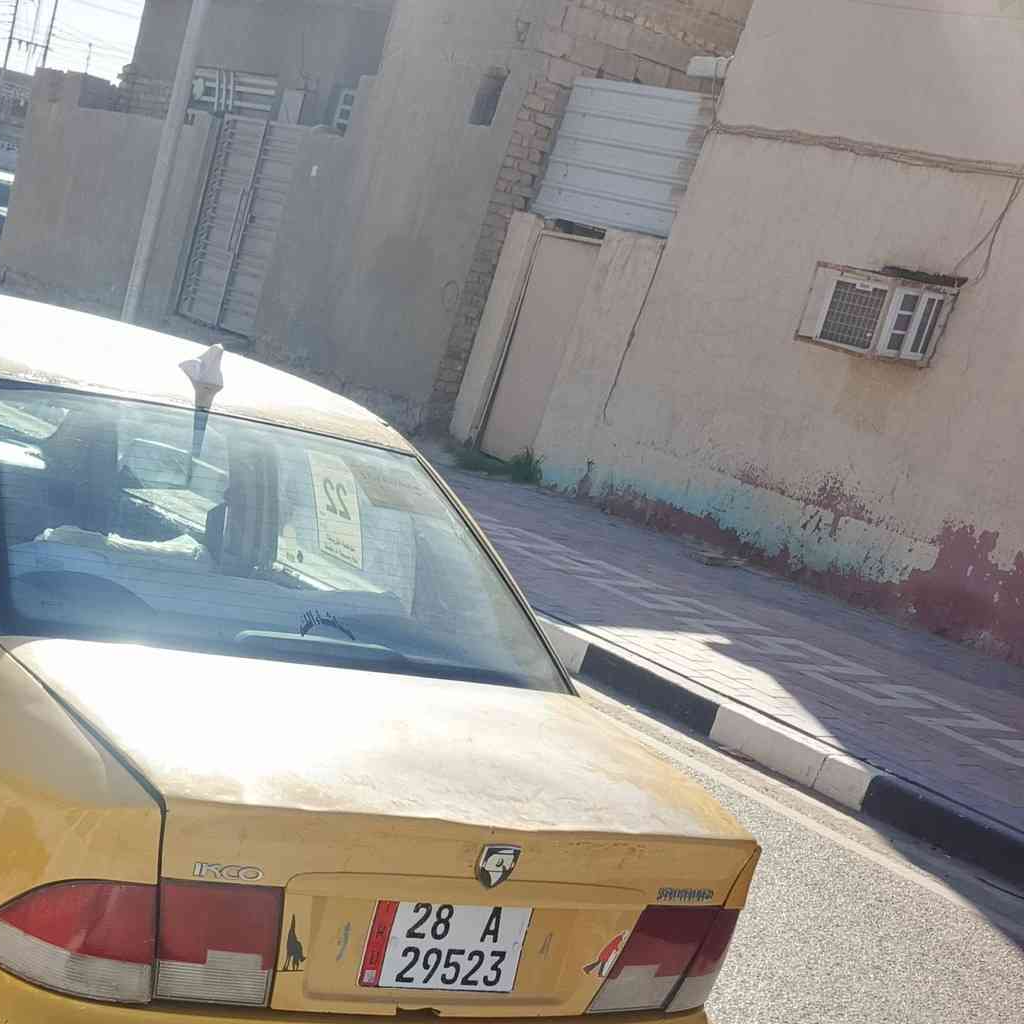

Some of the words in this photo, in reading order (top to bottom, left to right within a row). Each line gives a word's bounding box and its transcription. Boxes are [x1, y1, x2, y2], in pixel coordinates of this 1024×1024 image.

[191, 861, 264, 881] IKCO
[406, 902, 455, 941] 28
[479, 906, 503, 943] A
[395, 946, 507, 987] 29523
